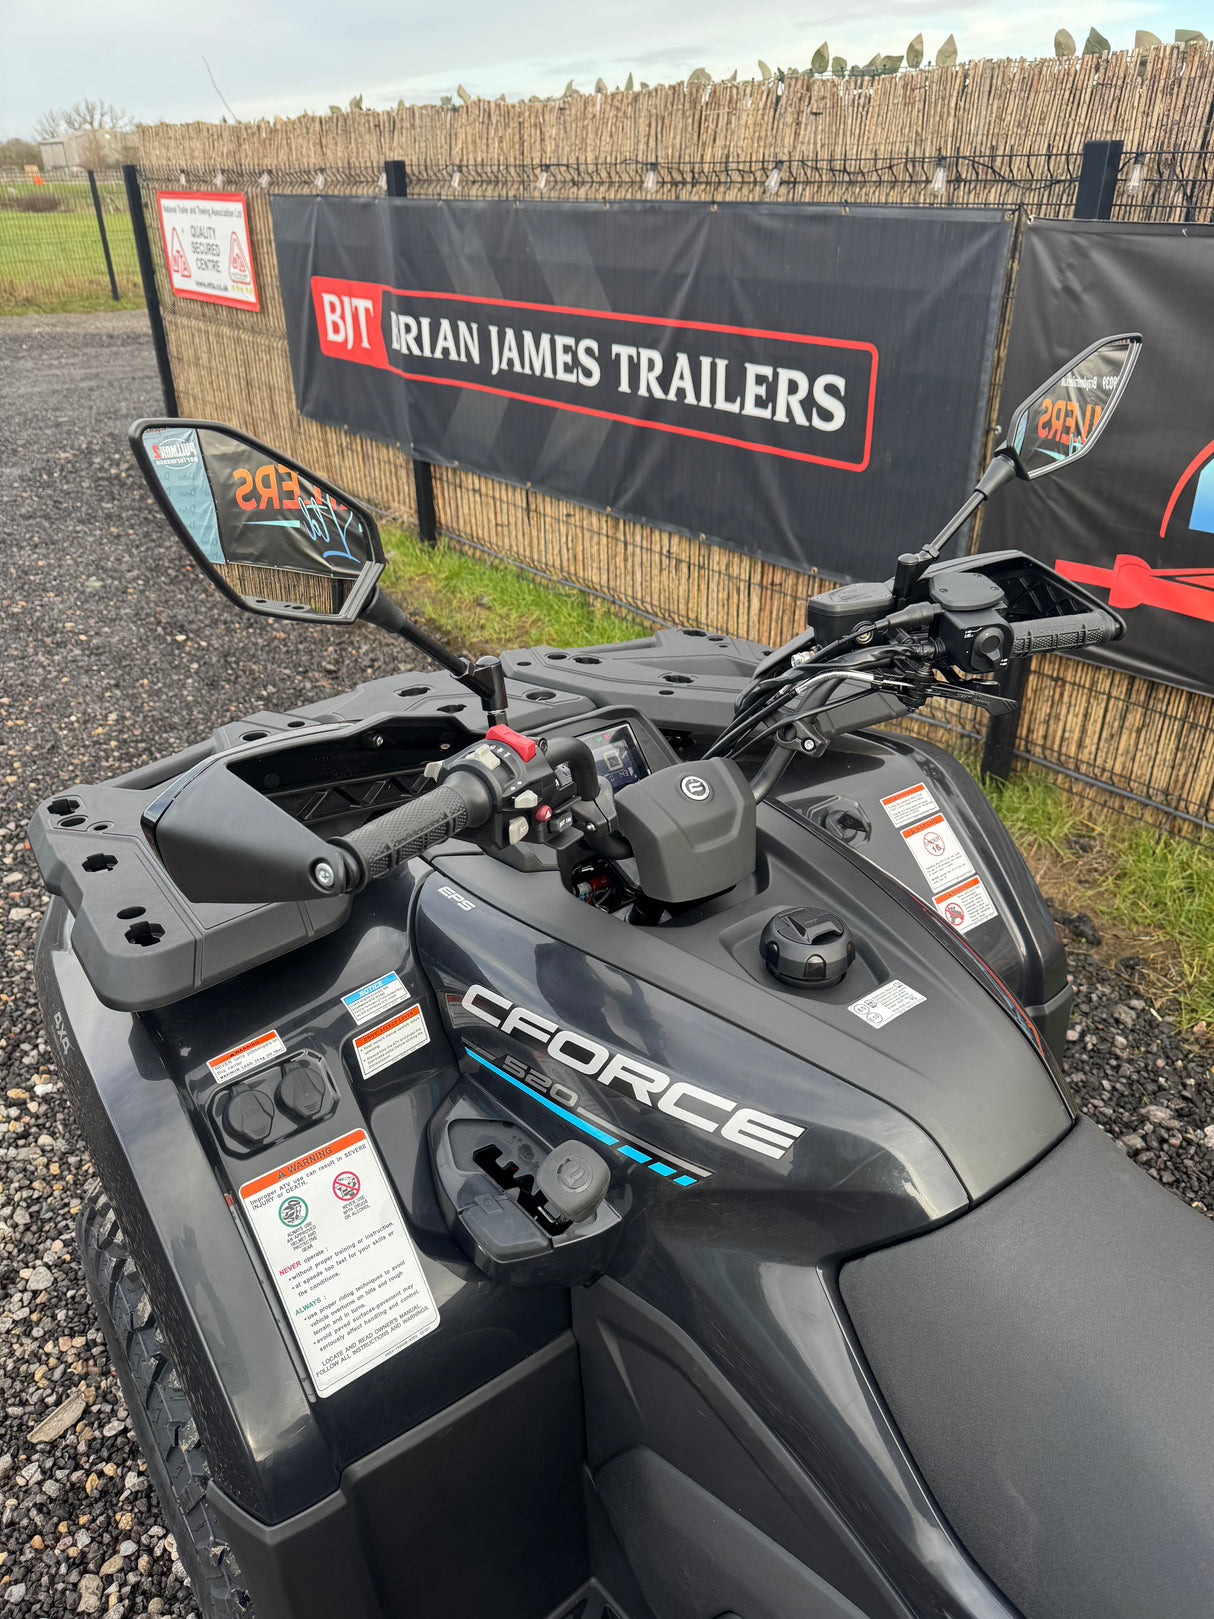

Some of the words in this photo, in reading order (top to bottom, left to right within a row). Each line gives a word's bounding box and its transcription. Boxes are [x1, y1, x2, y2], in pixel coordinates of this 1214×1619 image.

[190, 225, 216, 240] QUALITY
[192, 241, 221, 257] SECURED
[196, 257, 222, 273] CENTRE
[320, 292, 375, 350] BJT
[391, 310, 481, 366] BRIAN
[487, 324, 602, 388] JAMES
[611, 342, 847, 432] TRAILERS
[437, 886, 477, 912] EPS
[357, 980, 383, 997] NOTICE
[363, 1030, 378, 1042] DRIVE
[379, 1020, 399, 1033] SELECT
[398, 1010, 414, 1022] LEVER
[233, 1040, 260, 1055] WARNING
[214, 1059, 233, 1071] NEVER
[461, 983, 806, 1160] CFORCE
[502, 1054, 579, 1108] 520
[287, 1146, 333, 1175] WARNING
[249, 1189, 277, 1207] Improper
[279, 1181, 293, 1192] ATV
[292, 1176, 304, 1184] use
[305, 1169, 317, 1178] can
[318, 1159, 336, 1172] result
[343, 1143, 367, 1159] SEVERE
[252, 1196, 274, 1211] INJURY
[285, 1180, 308, 1194] DEATH.
[341, 1199, 357, 1210] NEVER
[355, 1194, 366, 1203] USE
[342, 1206, 354, 1216] WITH
[353, 1198, 369, 1210] DRUGS
[344, 1213, 352, 1221] OR
[351, 1204, 371, 1217] ALCOHOL
[286, 1236, 294, 1244] AN
[294, 1224, 317, 1240] APPROVED
[287, 1226, 304, 1238] ALWAYS
[303, 1220, 313, 1229] USE
[290, 1235, 307, 1248] HELMET
[307, 1230, 317, 1239] AND
[289, 1265, 313, 1281] without
[314, 1254, 333, 1269] proper
[334, 1242, 356, 1257] training
[364, 1222, 395, 1240] instruction.
[292, 1235, 318, 1252] PROTECTIVE
[301, 1243, 314, 1253] GEAR
[278, 1260, 302, 1277] NEVER
[303, 1249, 324, 1264] operate
[302, 1270, 324, 1285] speeds
[324, 1264, 335, 1273] too
[335, 1256, 348, 1266] fast
[348, 1251, 357, 1260] for
[357, 1243, 371, 1255] your
[372, 1235, 387, 1246] skills
[297, 1289, 308, 1298] the
[309, 1272, 341, 1291] conditions.
[306, 1311, 318, 1320] use
[318, 1299, 337, 1315] proper
[338, 1290, 355, 1303] riding
[355, 1273, 384, 1293] techniques
[391, 1259, 406, 1272] avoid
[309, 1314, 330, 1328] vehicle
[330, 1299, 356, 1316] overturns
[364, 1287, 377, 1296] hills
[377, 1279, 388, 1289] and
[388, 1270, 404, 1283] rough
[295, 1297, 322, 1317] ALWAYS
[312, 1323, 331, 1336] terrain
[332, 1314, 343, 1325] and
[350, 1303, 367, 1314] turns.
[316, 1331, 333, 1344] avoid
[333, 1320, 351, 1335] paved
[352, 1290, 402, 1323] surfaces-pavement
[402, 1283, 414, 1293] may
[319, 1334, 345, 1352] seriously
[346, 1323, 363, 1336] affect
[363, 1309, 388, 1326] handling
[388, 1300, 399, 1311] and
[400, 1289, 420, 1304] control.
[315, 1359, 340, 1378] FOLLOW
[340, 1353, 352, 1364] ALL
[351, 1329, 390, 1356] INSTRUCTIONS
[390, 1322, 402, 1333] AND
[401, 1305, 430, 1325] WARNINGS.
[321, 1349, 344, 1367] LOCATE
[345, 1342, 357, 1354] AND
[357, 1332, 374, 1345] READ
[374, 1316, 399, 1335] OWNER'S
[398, 1304, 422, 1320] MANUAL.
